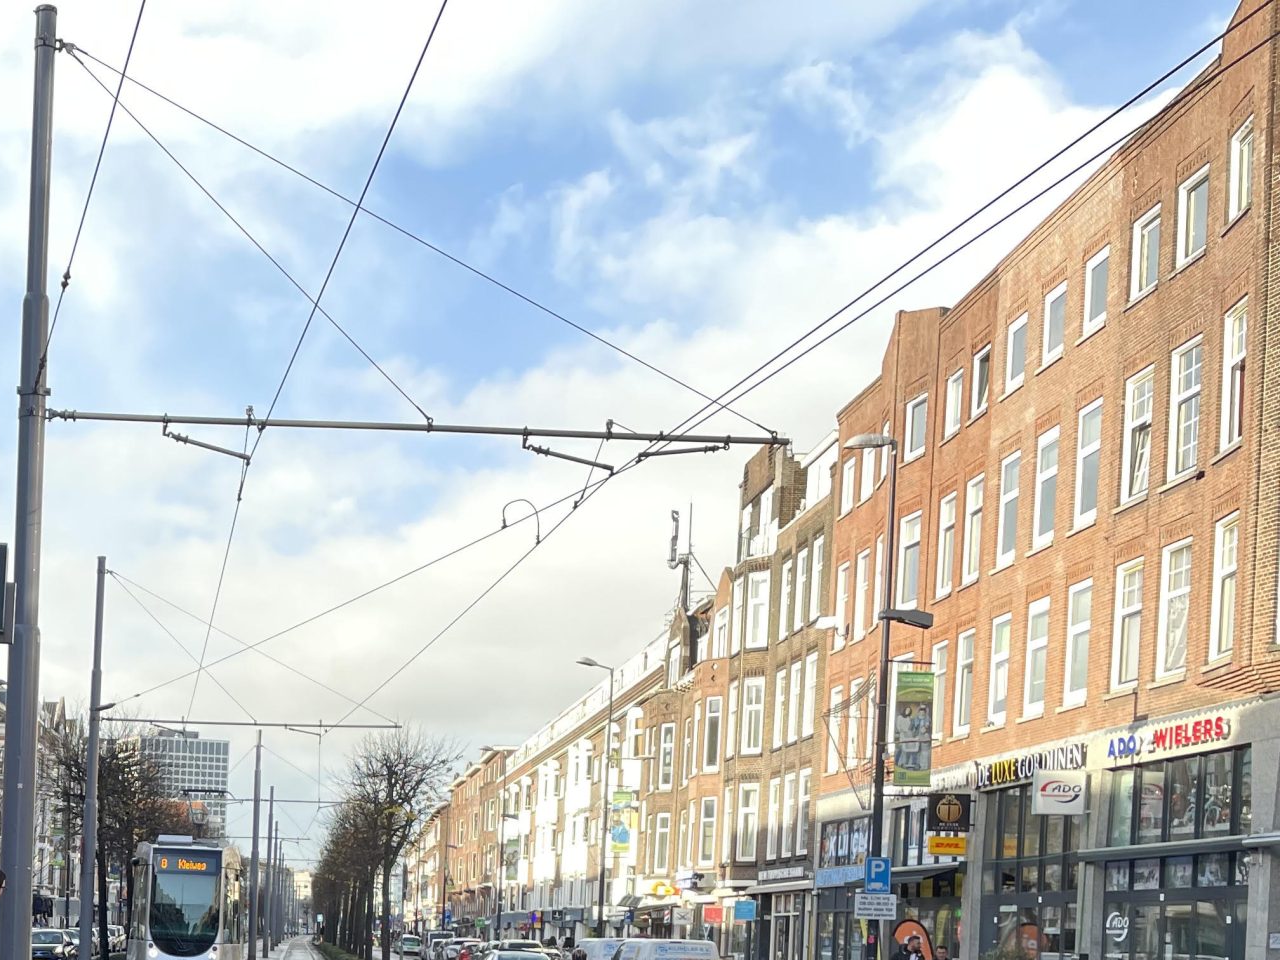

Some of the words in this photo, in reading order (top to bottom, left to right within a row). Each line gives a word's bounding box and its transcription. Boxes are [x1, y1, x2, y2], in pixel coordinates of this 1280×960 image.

[1108, 735, 1136, 758] ADO
[1153, 716, 1224, 750] WIELERS
[978, 764, 990, 787] DE
[991, 758, 1016, 784] LUXE
[1052, 784, 1082, 793] ADO
[871, 860, 885, 880] P
[1112, 916, 1129, 928] ADO
